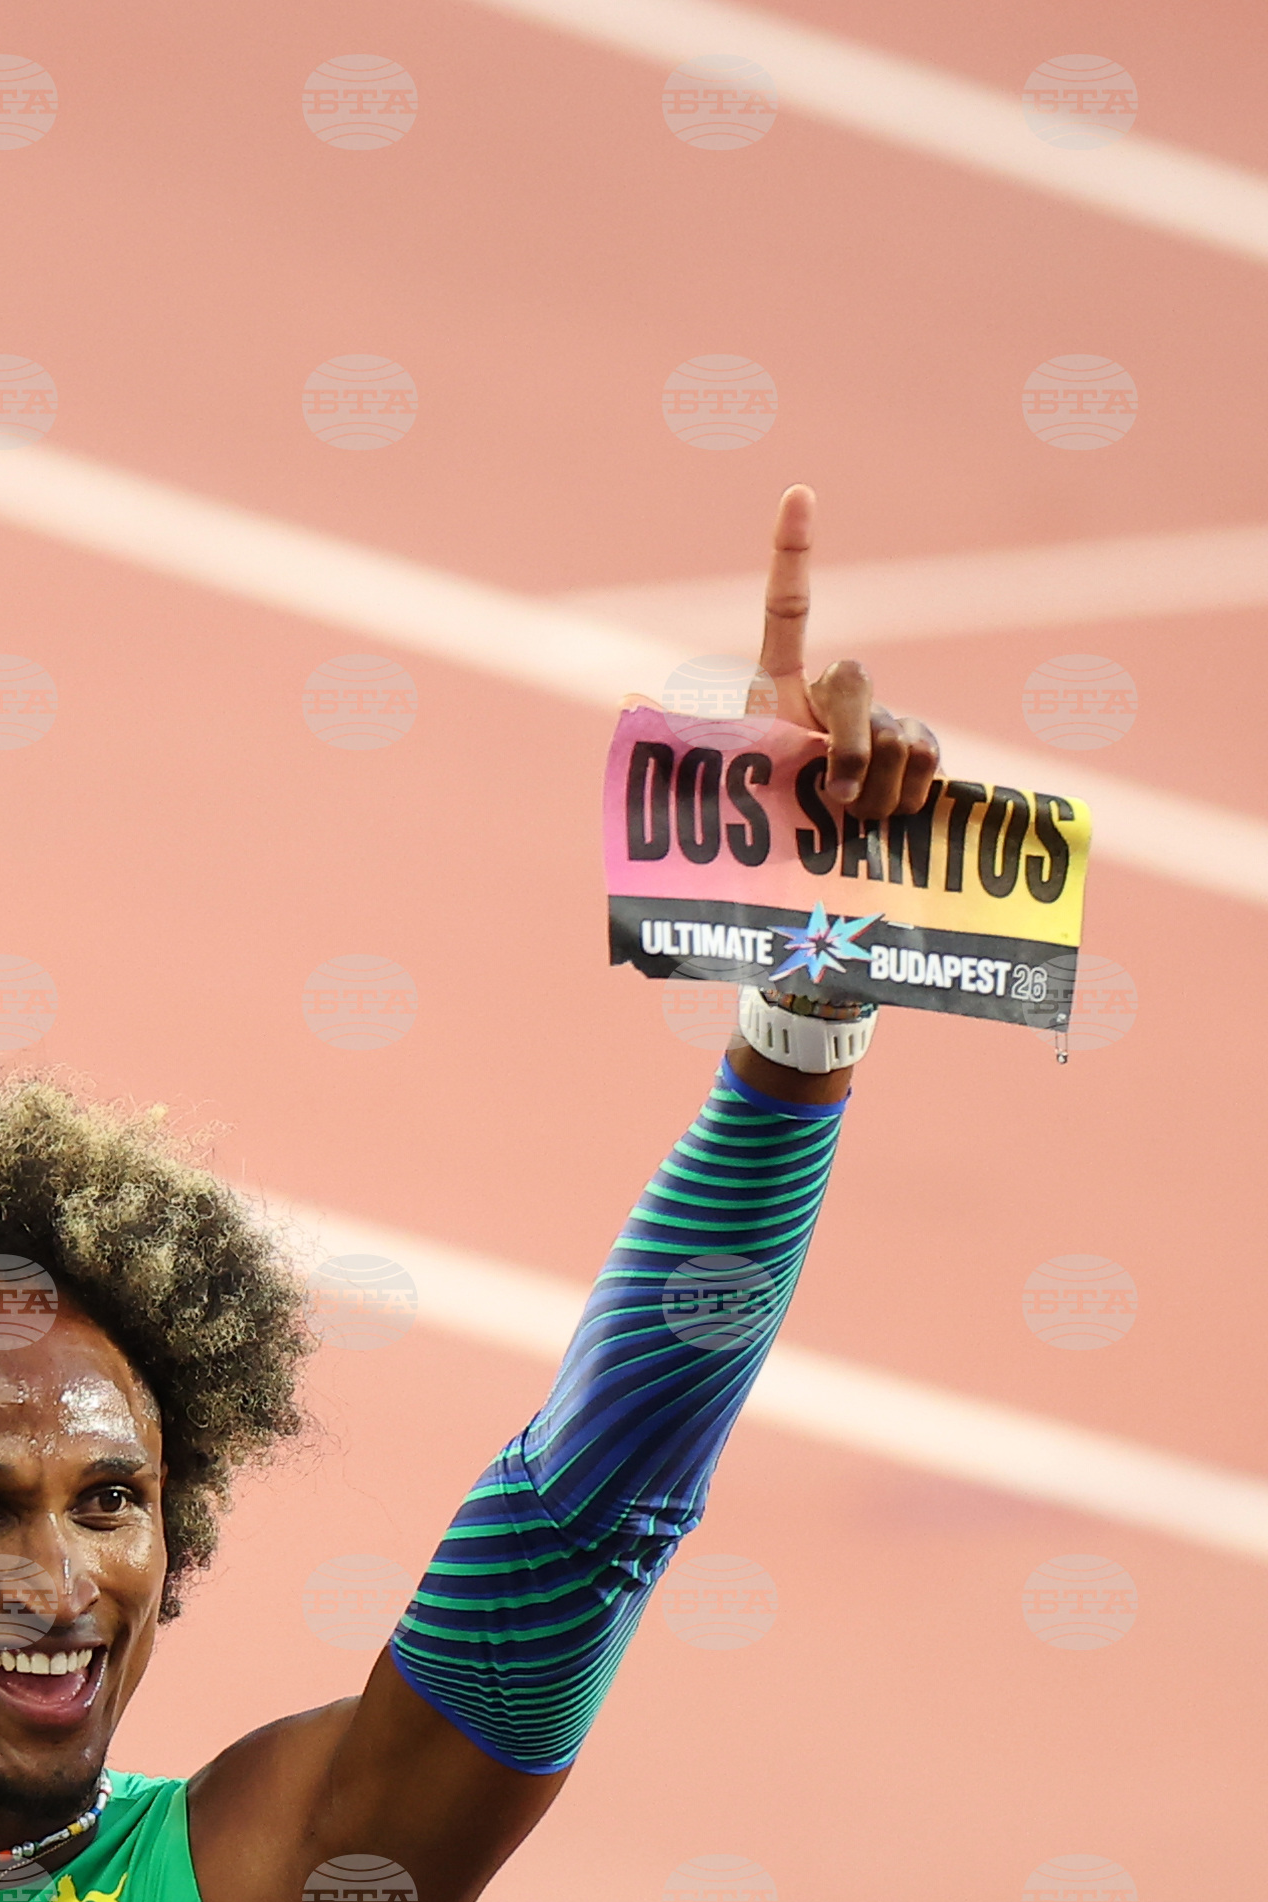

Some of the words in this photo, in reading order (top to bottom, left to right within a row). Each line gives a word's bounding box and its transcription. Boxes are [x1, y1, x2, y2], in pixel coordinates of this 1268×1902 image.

[626, 741, 773, 868] DOS
[795, 757, 1076, 905] SANTOS
[641, 919, 775, 966] ULTIMATE
